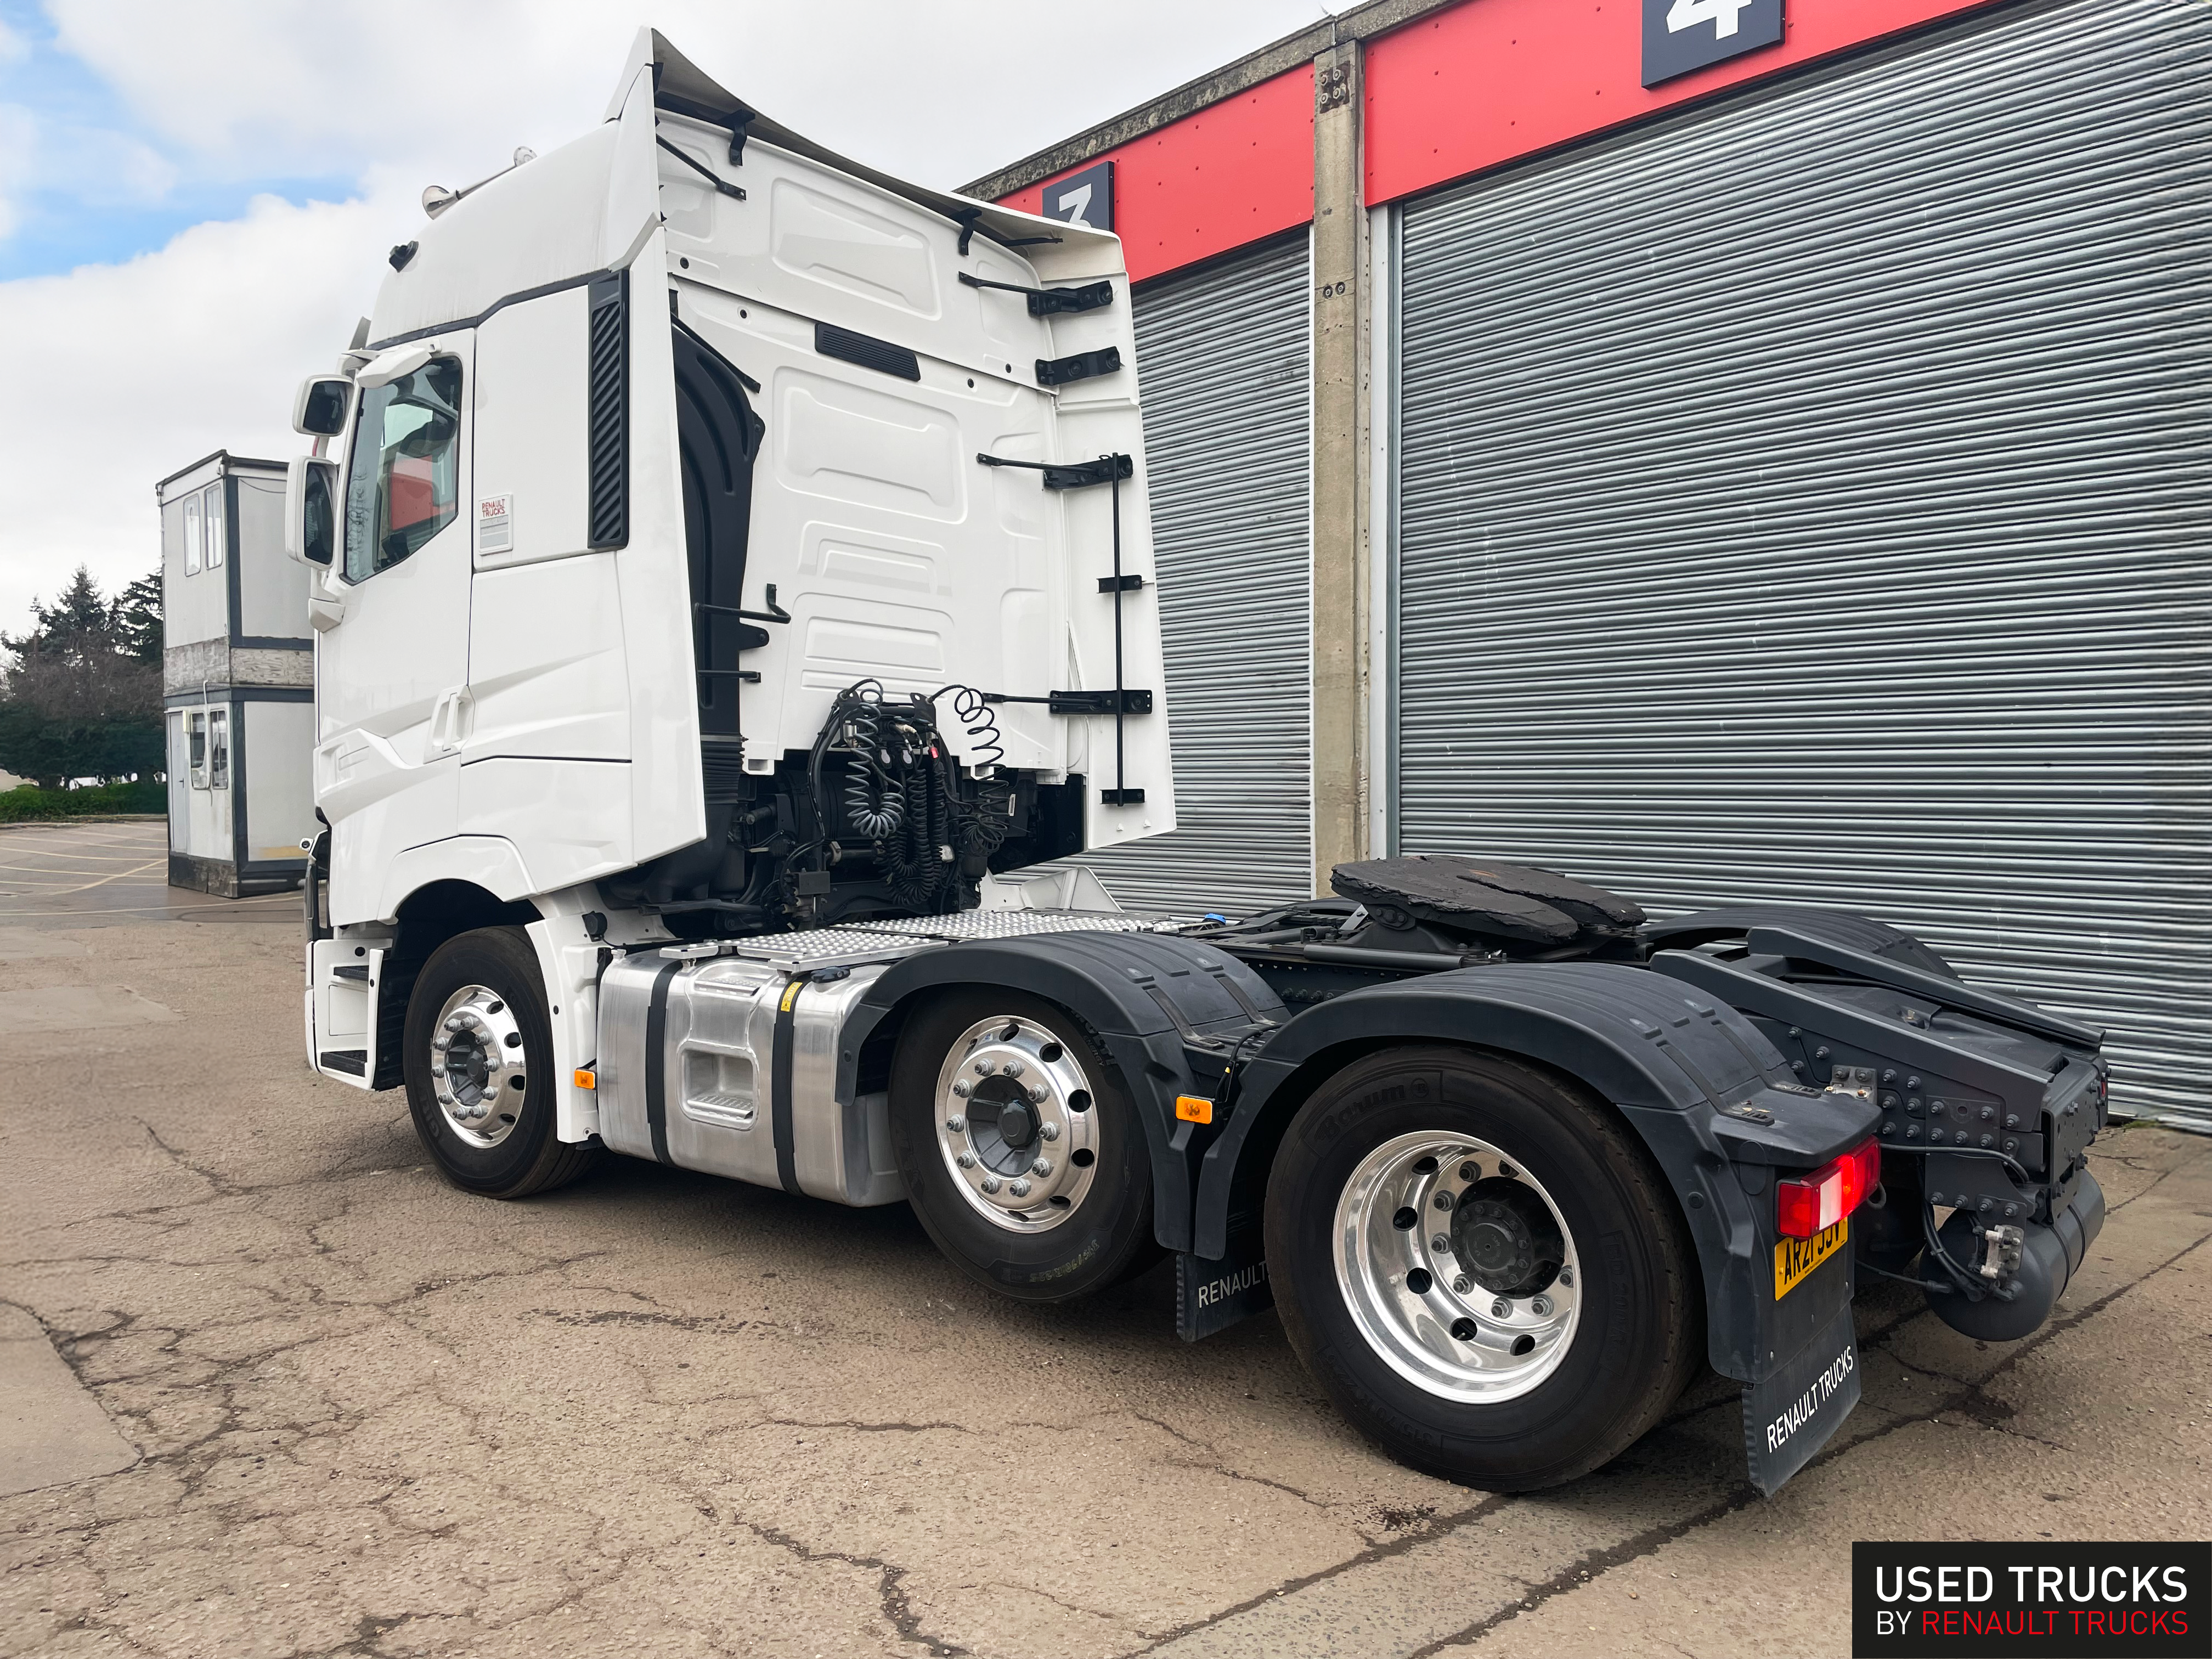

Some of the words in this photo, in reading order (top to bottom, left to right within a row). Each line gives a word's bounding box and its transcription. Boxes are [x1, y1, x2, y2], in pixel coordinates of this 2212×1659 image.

[1059, 183, 1092, 227] 3
[482, 499, 505, 510] RENAULT
[482, 506, 505, 518] TRUCKS
[1084, 1036, 1105, 1066] ENERGY
[1314, 1085, 1406, 1141] Barum
[1784, 1238, 1813, 1285] AR21
[1198, 1261, 1267, 1309] RENAULT
[1766, 1385, 1818, 1453] RENAULT
[1819, 1345, 1854, 1405] TRUCKS
